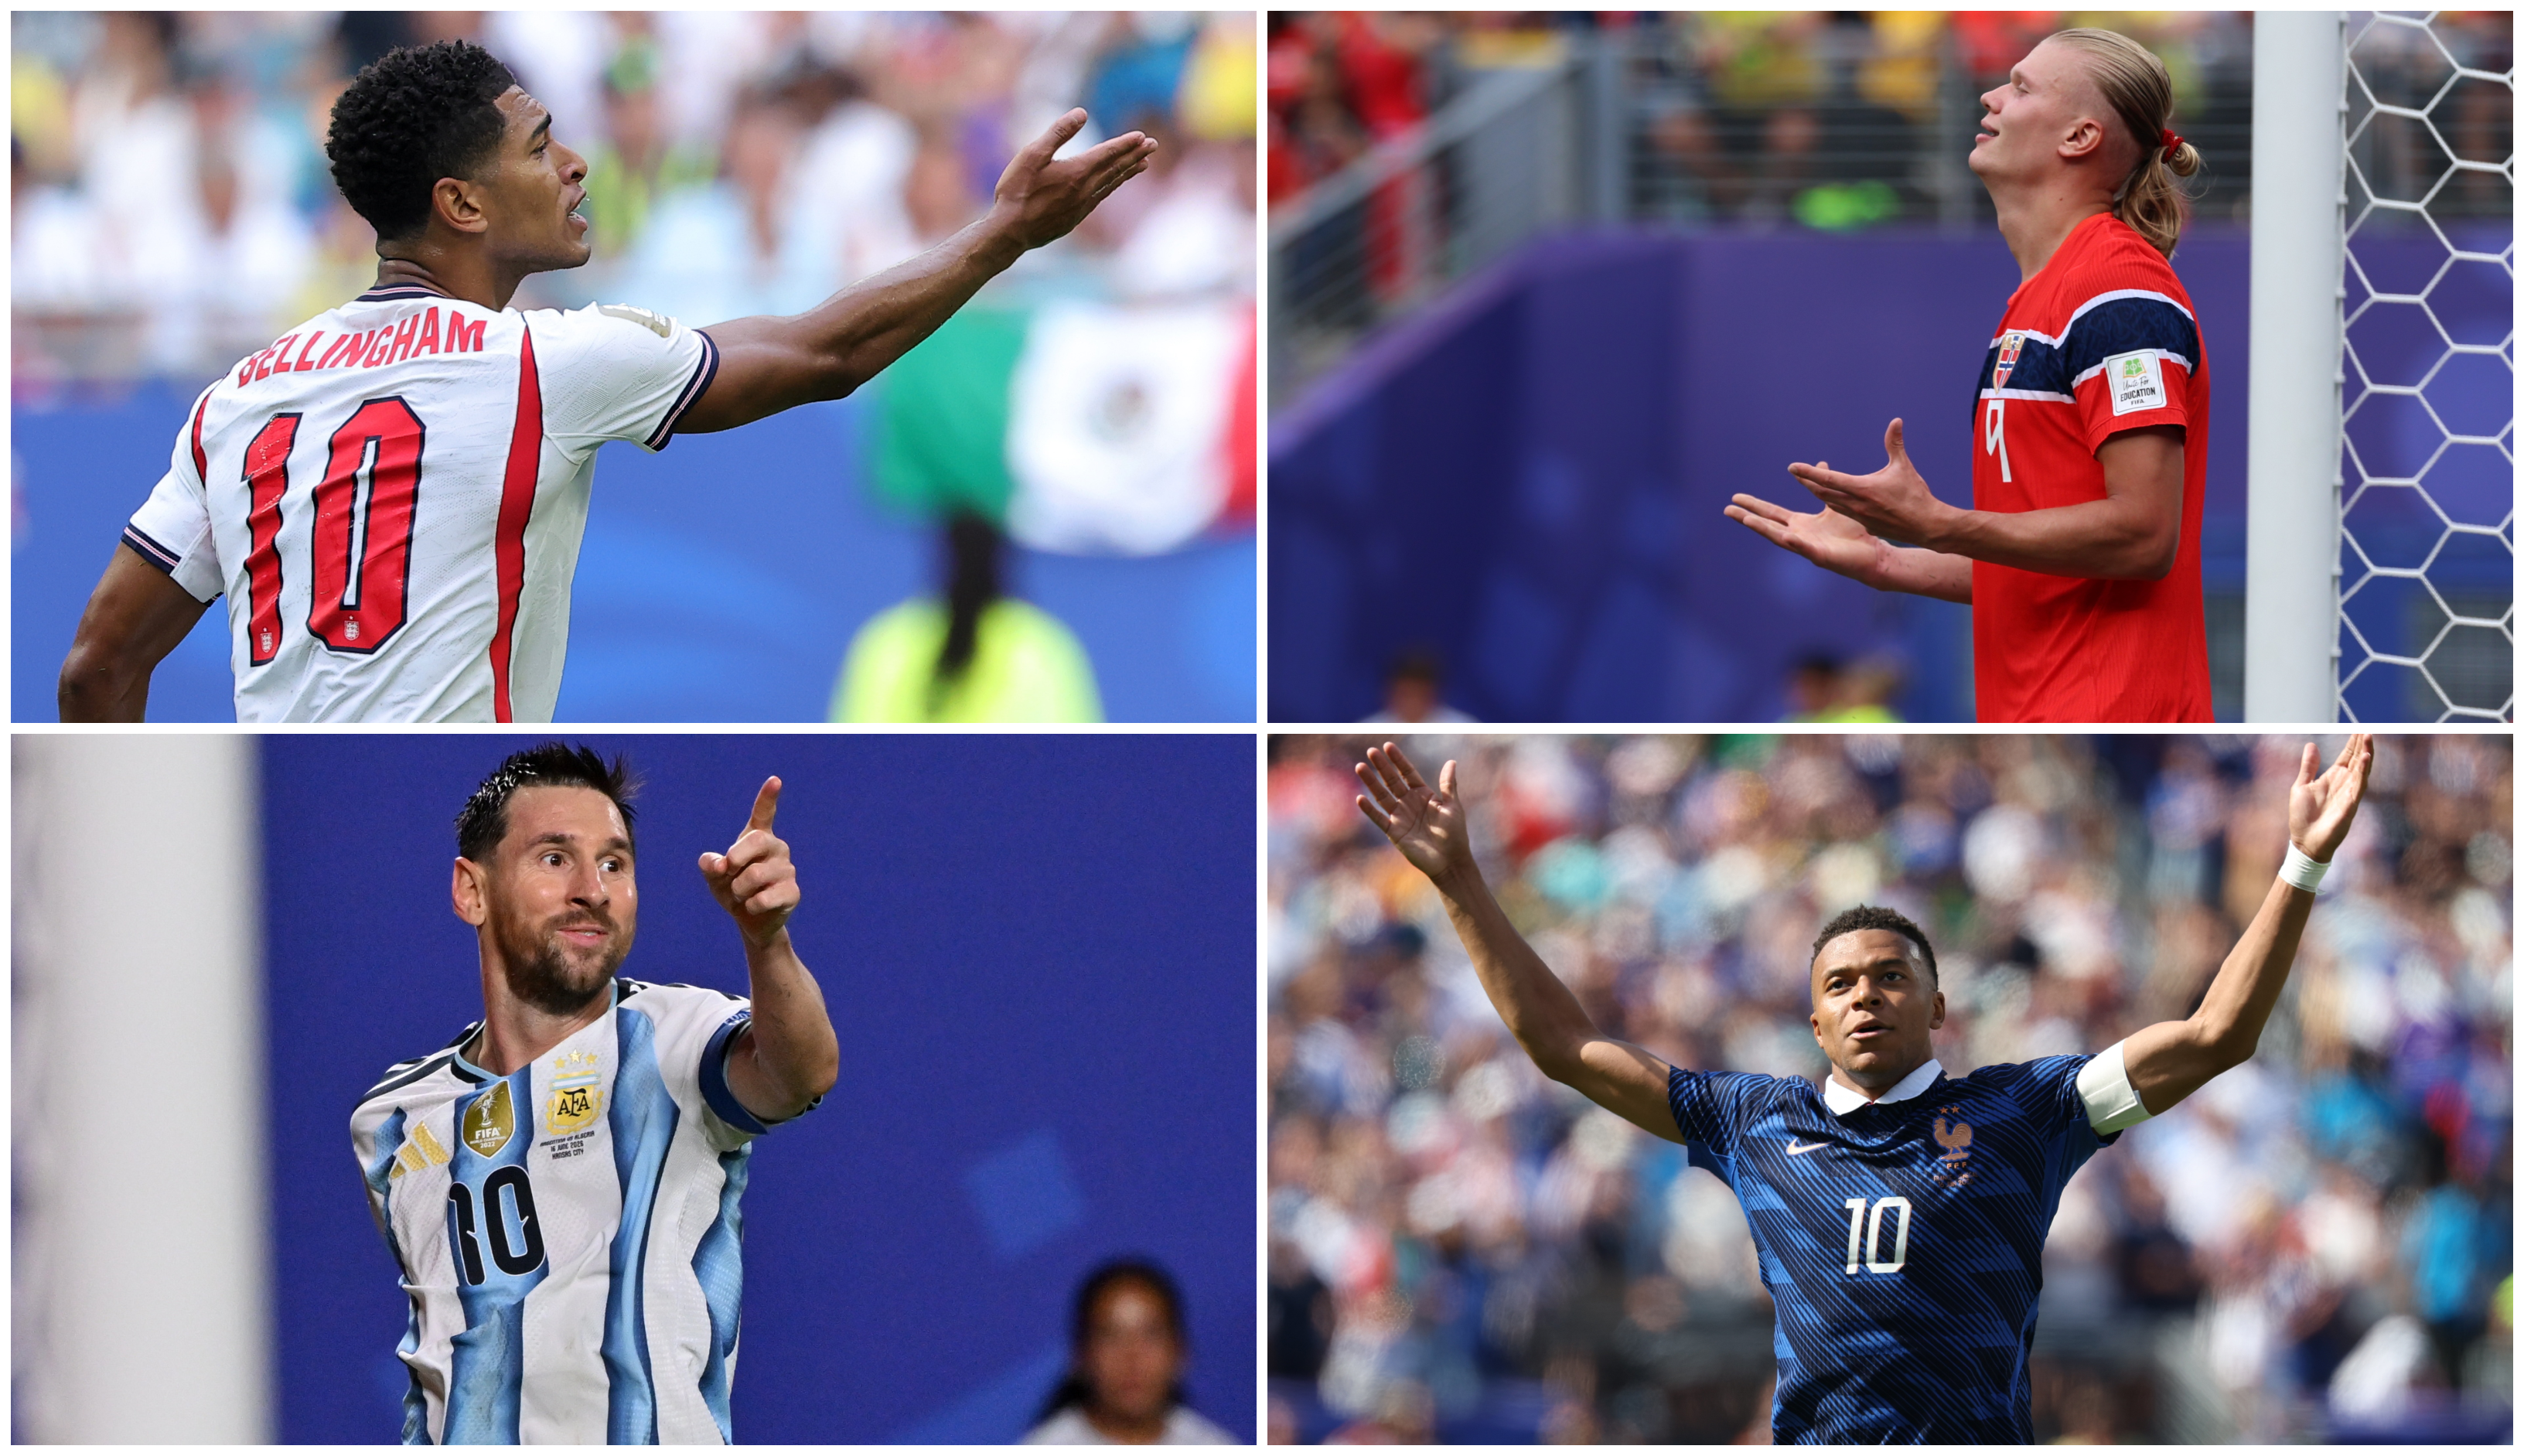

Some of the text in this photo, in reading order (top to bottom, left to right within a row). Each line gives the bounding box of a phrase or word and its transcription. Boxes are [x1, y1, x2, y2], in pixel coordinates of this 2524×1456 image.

[237, 305, 488, 389] BELLINGHAM
[2139, 376, 2150, 387] For
[2120, 387, 2156, 402] EDUCATION
[1986, 399, 2011, 482] 9
[240, 395, 426, 667] 10
[557, 1088, 590, 1117] AFA
[475, 1127, 501, 1140] FIFA
[575, 1130, 595, 1140] ALGERIA
[479, 1141, 496, 1149] 2022
[557, 1143, 569, 1151] JUNE
[570, 1140, 584, 1149] 2026
[551, 1147, 585, 1160] KANSAS CITY
[449, 1164, 545, 1287] 10
[1845, 1196, 1912, 1274] 10
